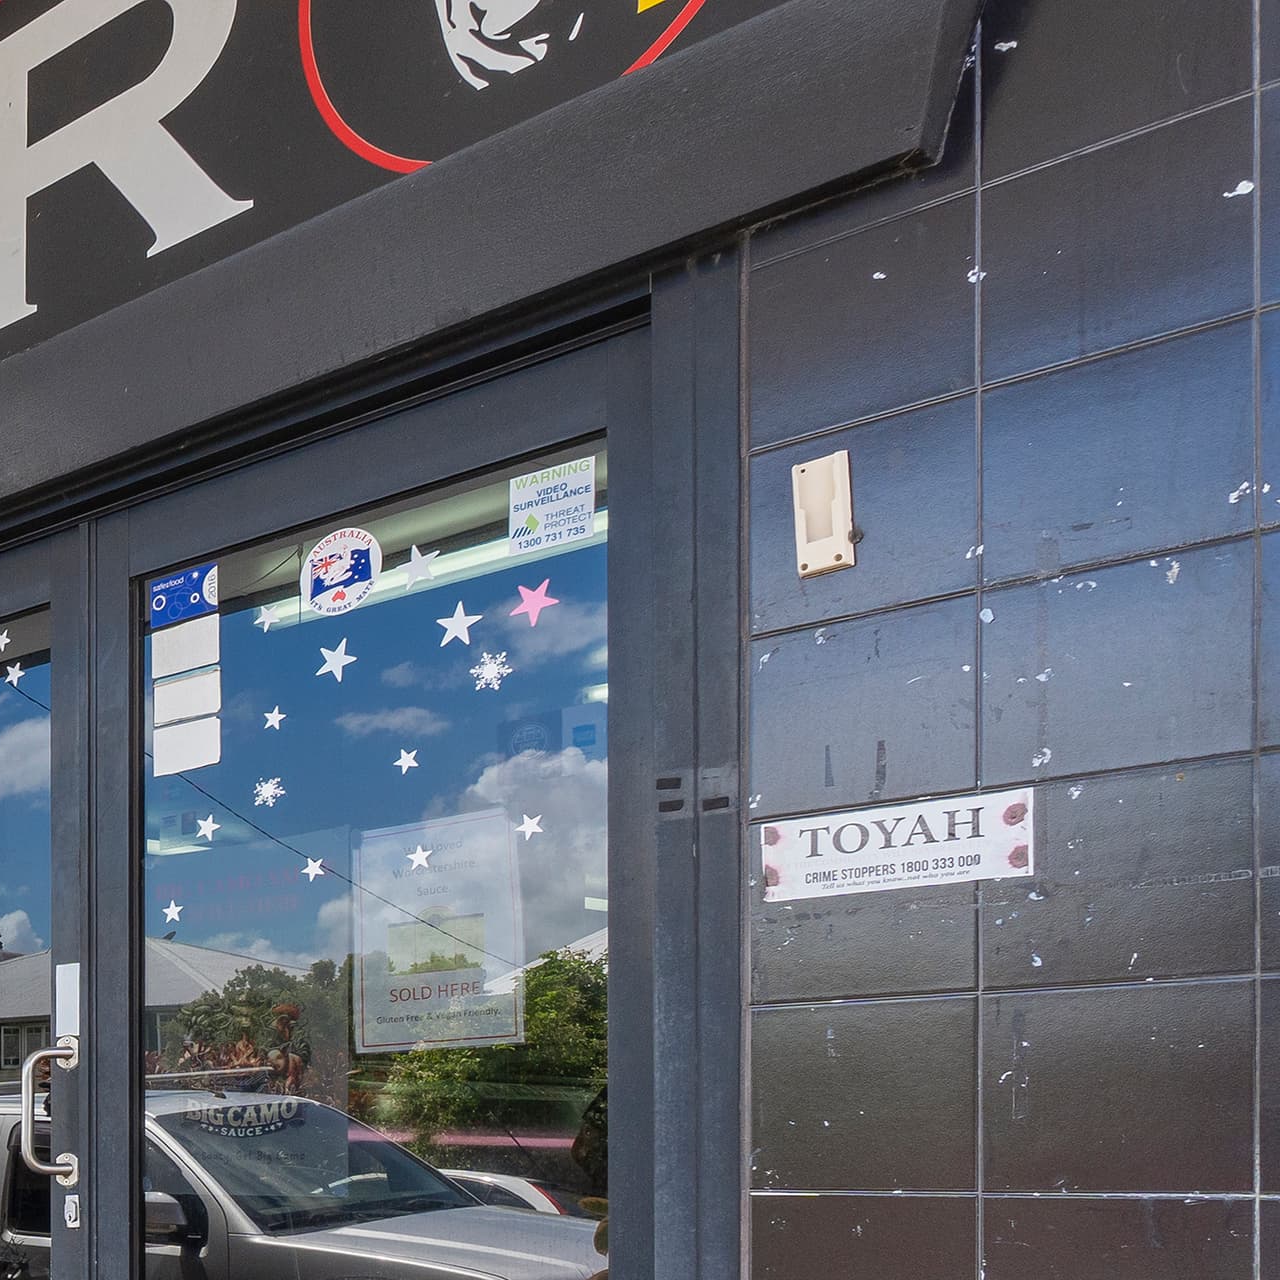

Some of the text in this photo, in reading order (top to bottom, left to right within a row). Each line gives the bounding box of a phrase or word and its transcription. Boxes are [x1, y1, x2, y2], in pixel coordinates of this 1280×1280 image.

[515, 460, 591, 490] WARNING
[513, 484, 592, 512] SURVEILLANCE
[536, 482, 568, 497] VIDEO
[544, 511, 592, 531] PROTECT
[545, 504, 586, 521] THREAT
[312, 530, 374, 558] AUSTRALIA
[518, 525, 586, 549] 1300 731 735
[799, 807, 985, 858] TOYAH
[805, 853, 981, 885] CRIME STOPPERS 1800 333 000
[390, 981, 481, 1003] SOLD HERE
[227, 1098, 298, 1127] CAMO
[220, 1127, 263, 1136] SAUCE
